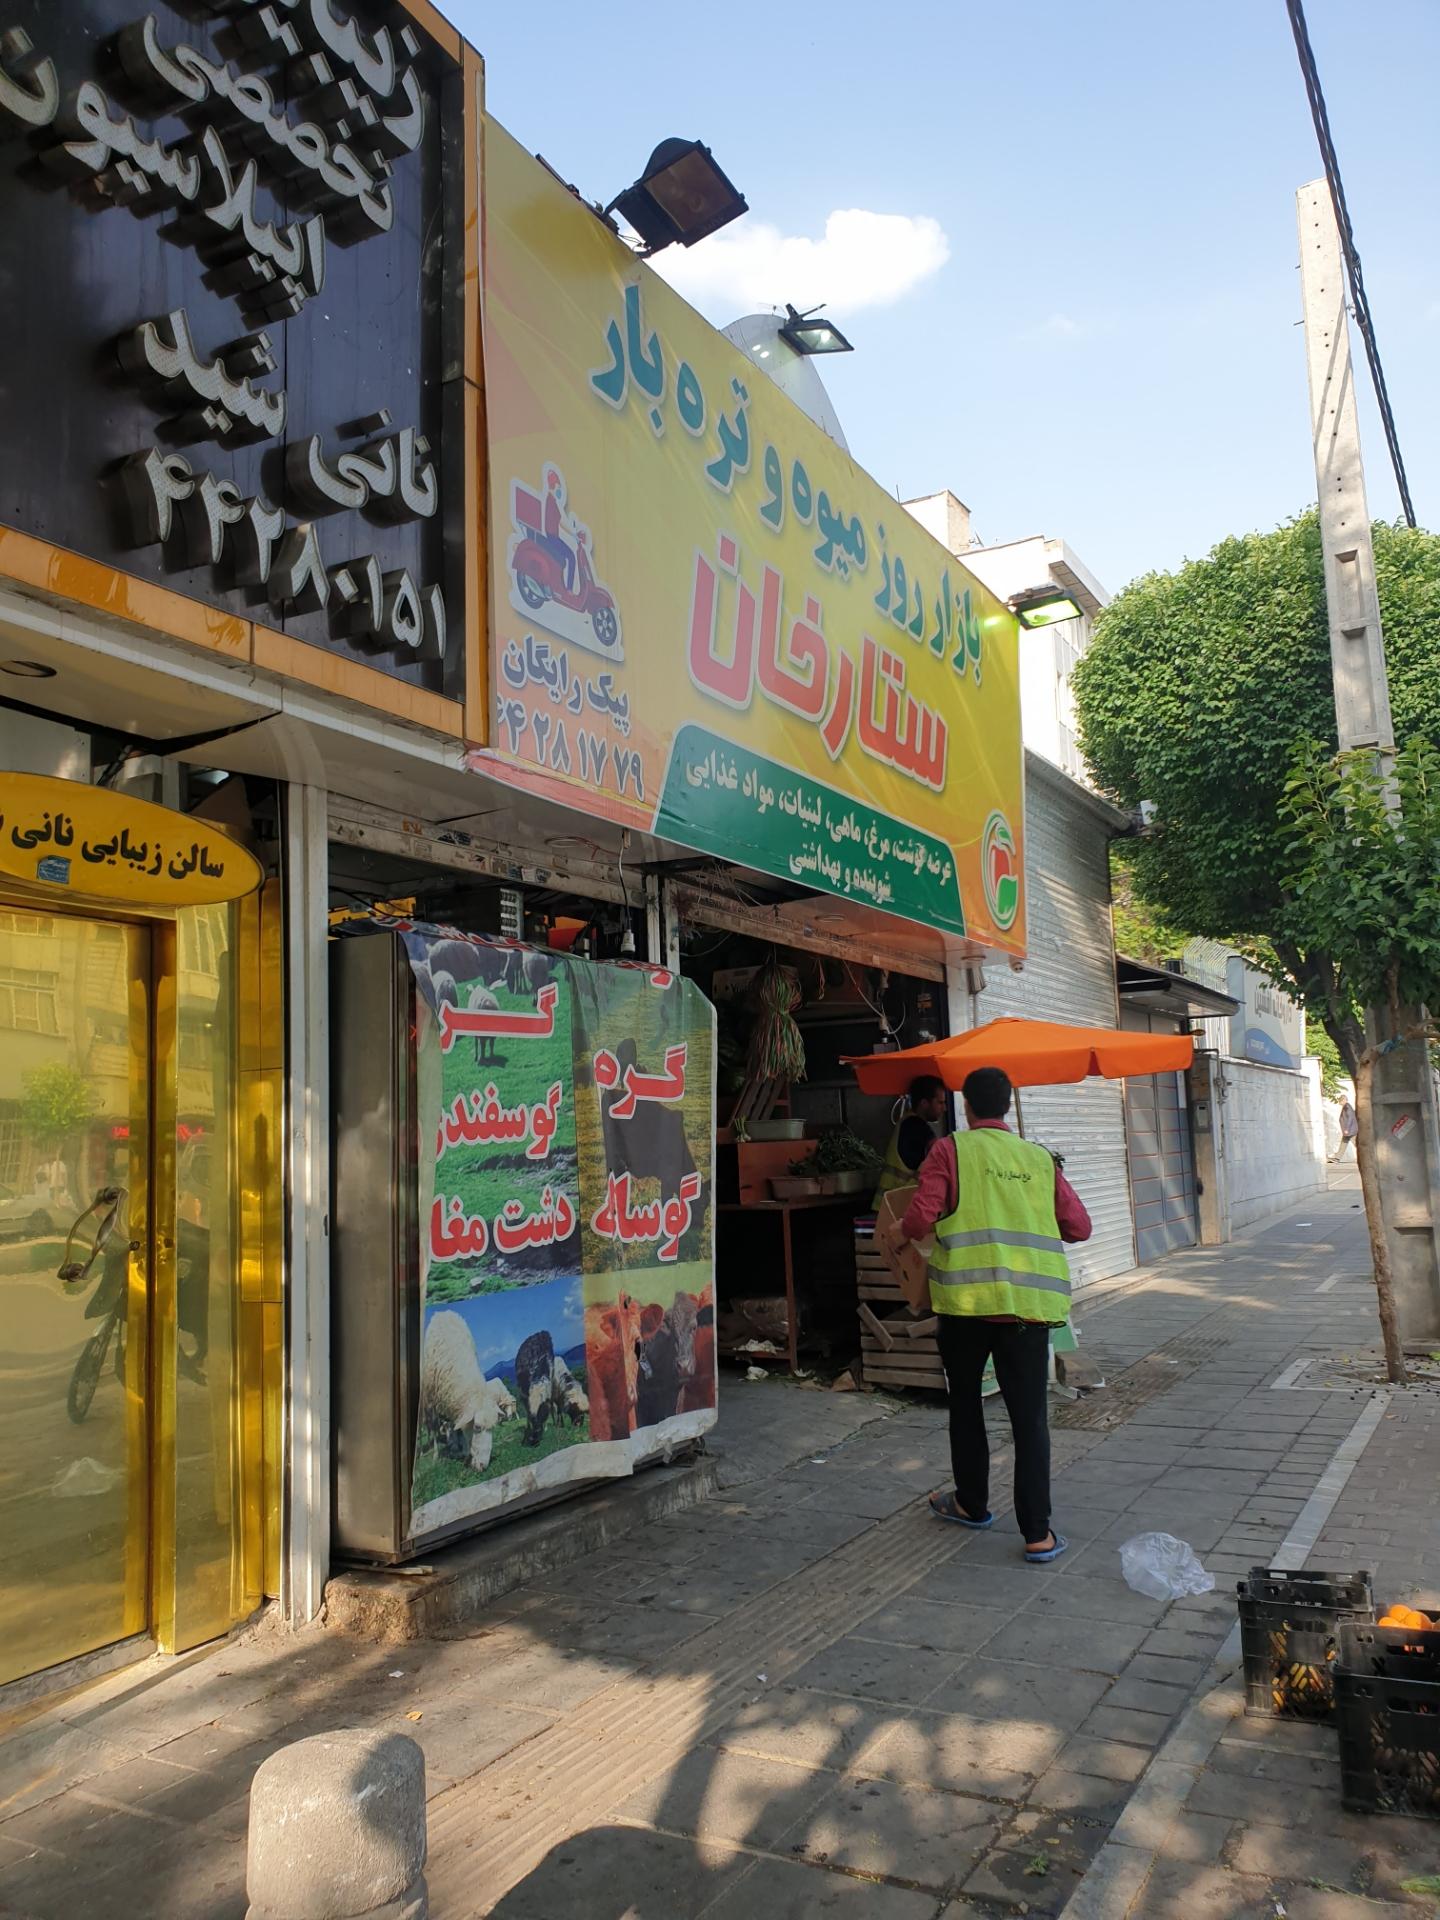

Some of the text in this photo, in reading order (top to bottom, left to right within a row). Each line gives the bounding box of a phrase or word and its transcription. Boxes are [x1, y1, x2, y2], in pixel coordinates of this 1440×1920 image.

[143, 12, 395, 232] تخصصی
[308, 408, 439, 517] نانی
[758, 445, 784, 529] و
[791, 458, 868, 579] میوه
[873, 522, 925, 640] روز
[689, 530, 948, 792] ستارخان
[928, 567, 982, 684] بازار
[503, 634, 630, 736] پیک رایگان
[686, 749, 739, 789] غذایی
[742, 767, 775, 814] مواد
[11, 811, 74, 849] نانی
[81, 827, 162, 876] زیبایی
[168, 843, 224, 880] سالن
[789, 841, 841, 889] بهداشتی
[926, 851, 952, 887] عرضه
[429, 1184, 577, 1263] دشت مغا
